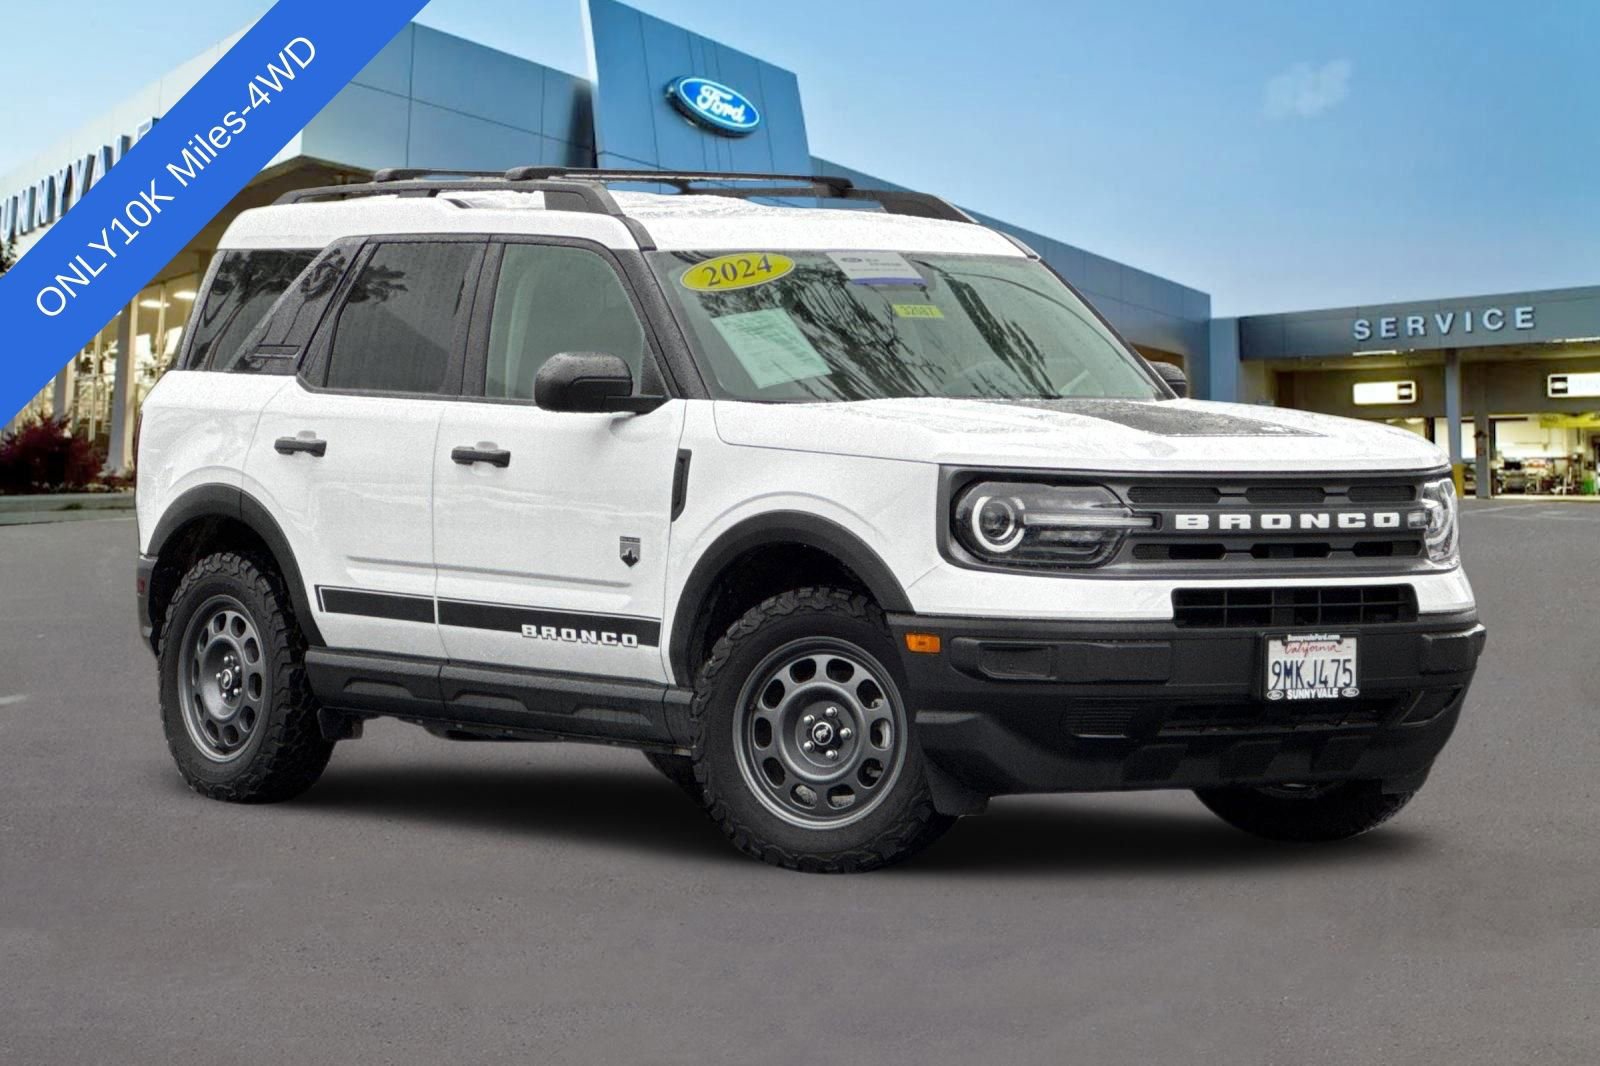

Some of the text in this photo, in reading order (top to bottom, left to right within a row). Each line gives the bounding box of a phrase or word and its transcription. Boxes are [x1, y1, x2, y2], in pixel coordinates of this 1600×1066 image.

[696, 84, 746, 122] Ford
[702, 254, 772, 287] 2024
[1353, 306, 1535, 341] SERVICE
[1175, 512, 1400, 530] BRONCO
[521, 624, 638, 648] BRONCO
[1284, 640, 1342, 657] California
[1271, 659, 1353, 690] 9MKJ475
[1286, 687, 1339, 700] SUNNYVALE
